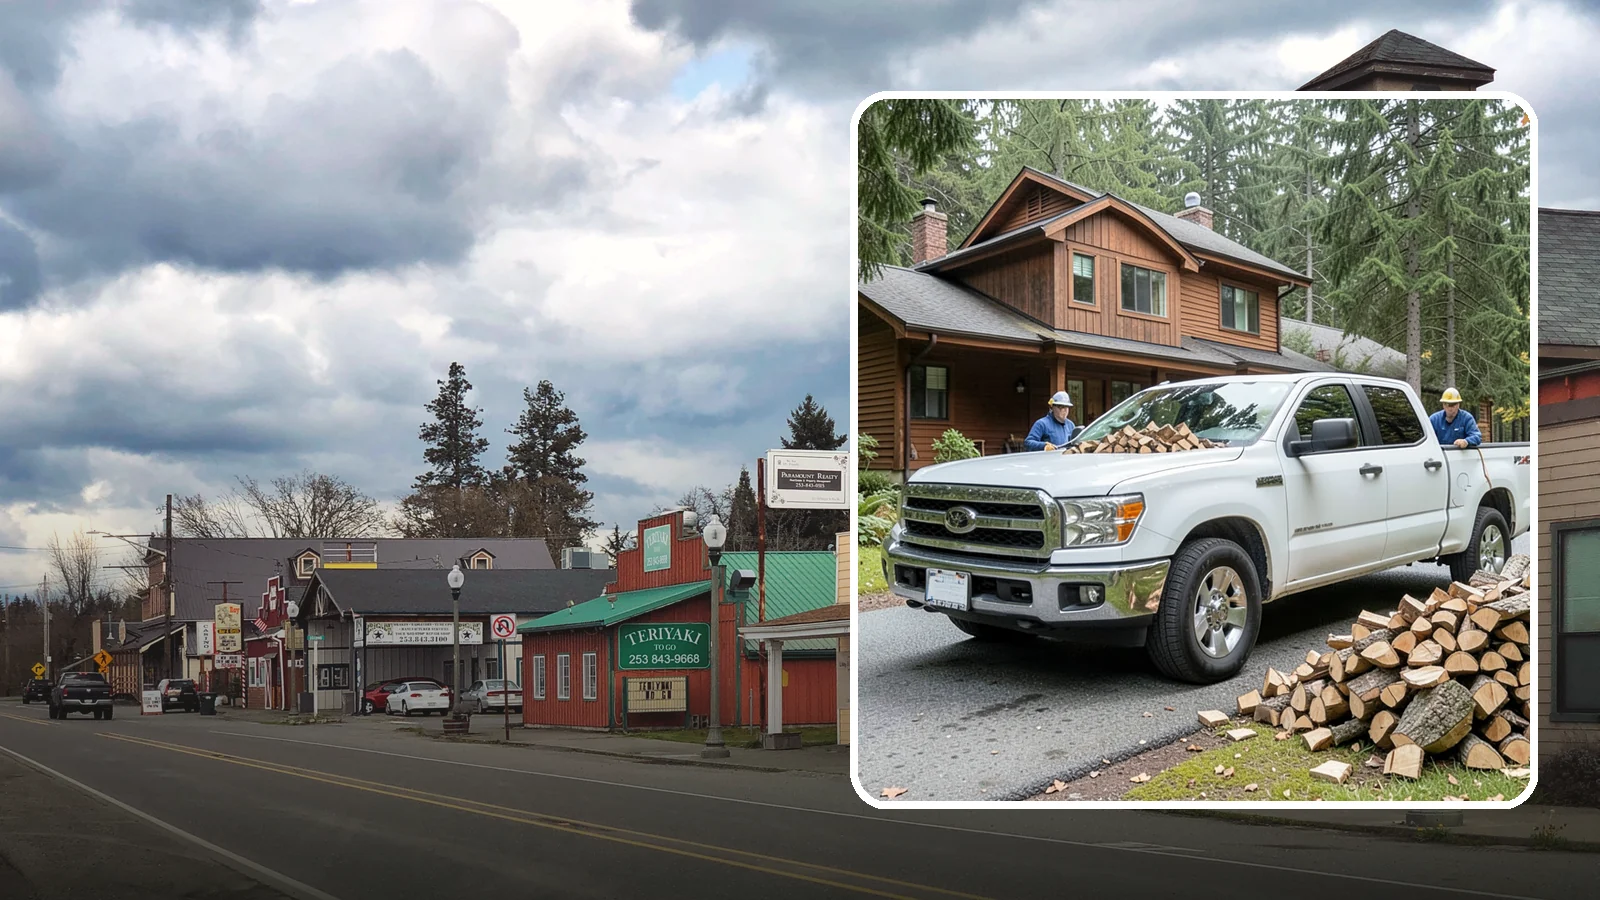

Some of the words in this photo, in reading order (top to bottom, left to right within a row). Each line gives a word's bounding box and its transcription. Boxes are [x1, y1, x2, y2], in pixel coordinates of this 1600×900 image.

[781, 471, 815, 479] PARAMOUNT
[817, 472, 839, 480] REALTY
[625, 627, 702, 646] TERIYAKI
[629, 654, 648, 665] 253
[651, 654, 700, 664] 843-9668
[639, 681, 673, 691] TERIYAKI
